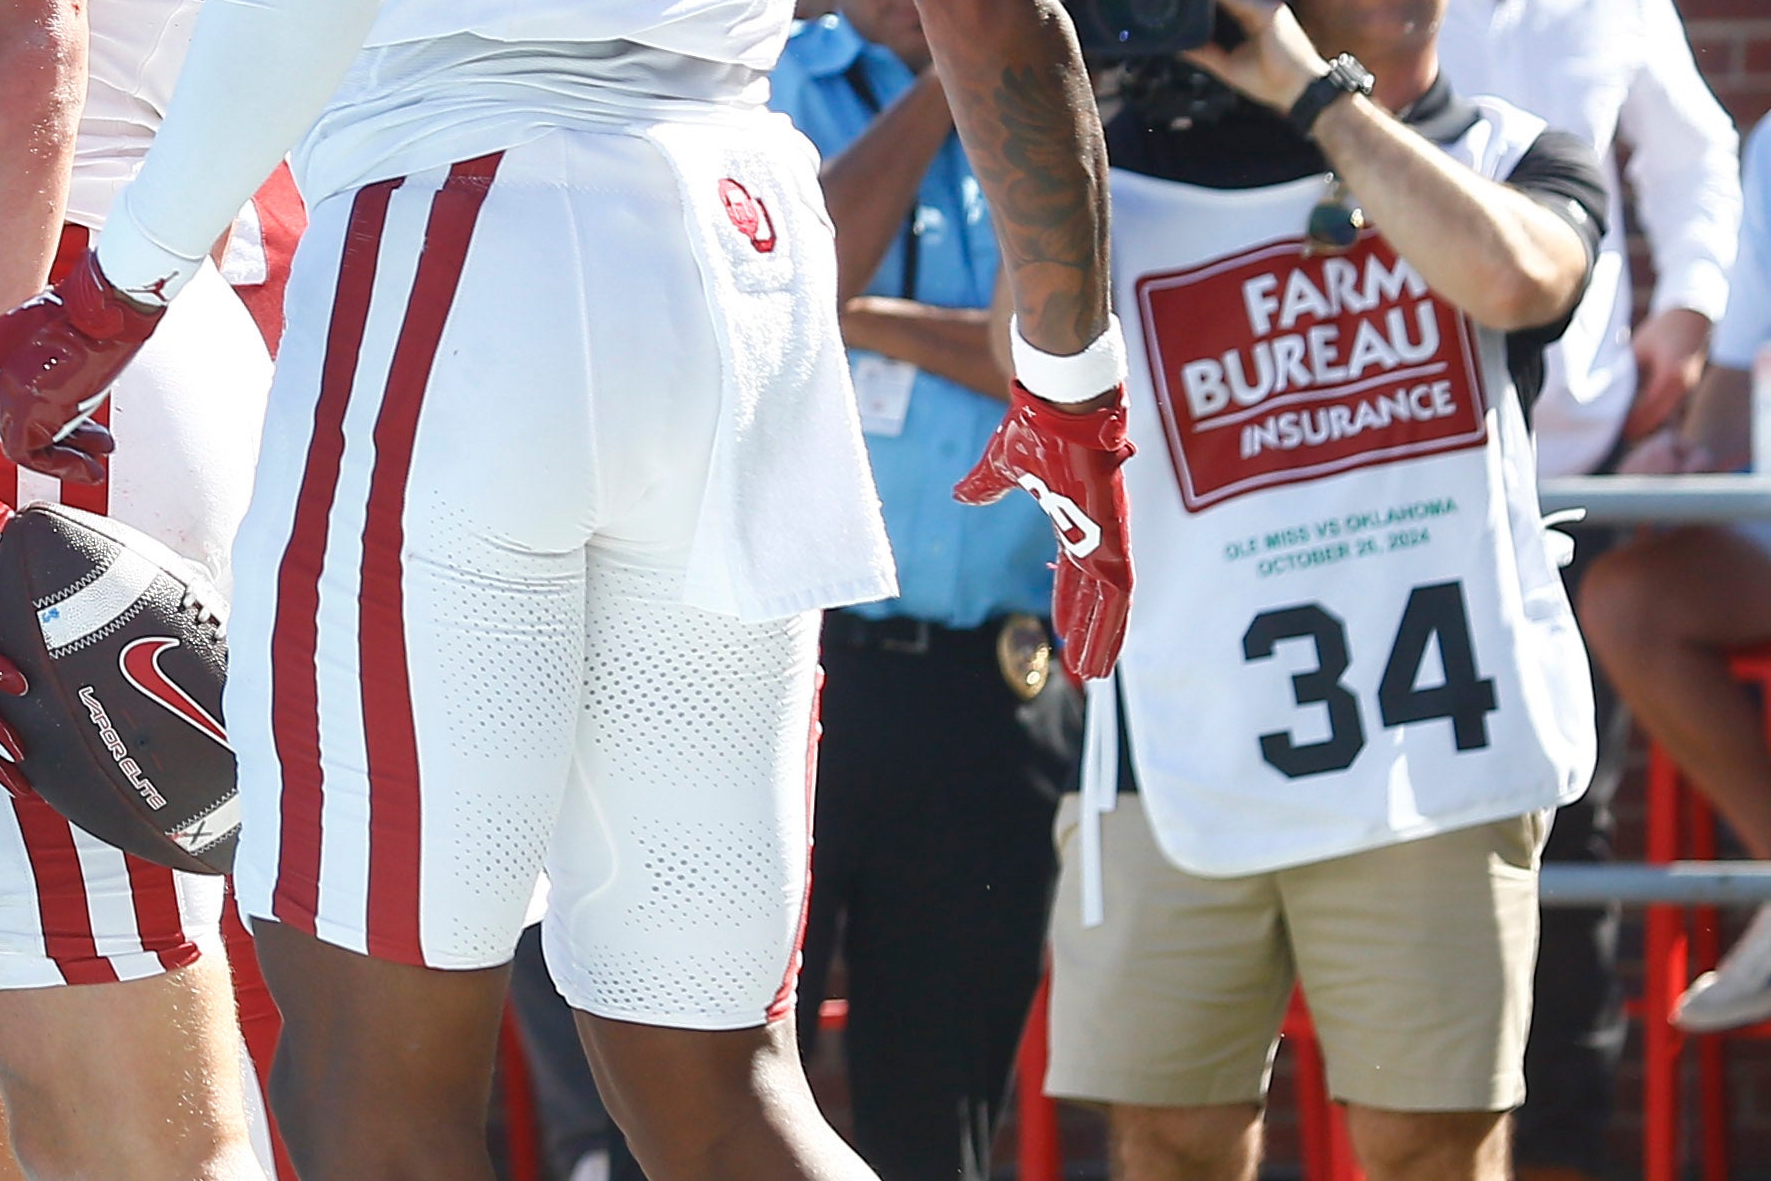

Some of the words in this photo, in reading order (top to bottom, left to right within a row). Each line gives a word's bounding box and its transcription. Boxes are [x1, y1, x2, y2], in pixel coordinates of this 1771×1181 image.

[1242, 253, 1429, 337] FARM
[1181, 299, 1441, 420] BUREAU
[1240, 379, 1458, 460] INSURANCE
[1225, 536, 1258, 561] OLE
[1264, 527, 1310, 551] MISS
[1315, 518, 1341, 538] VS
[1346, 496, 1459, 531] OKLAHOMA
[1258, 542, 1352, 577] OCTOBER
[1388, 526, 1430, 552] 2024
[1242, 580, 1498, 779] 34
[78, 686, 123, 762] VAPOR
[118, 757, 167, 811] ELITE
